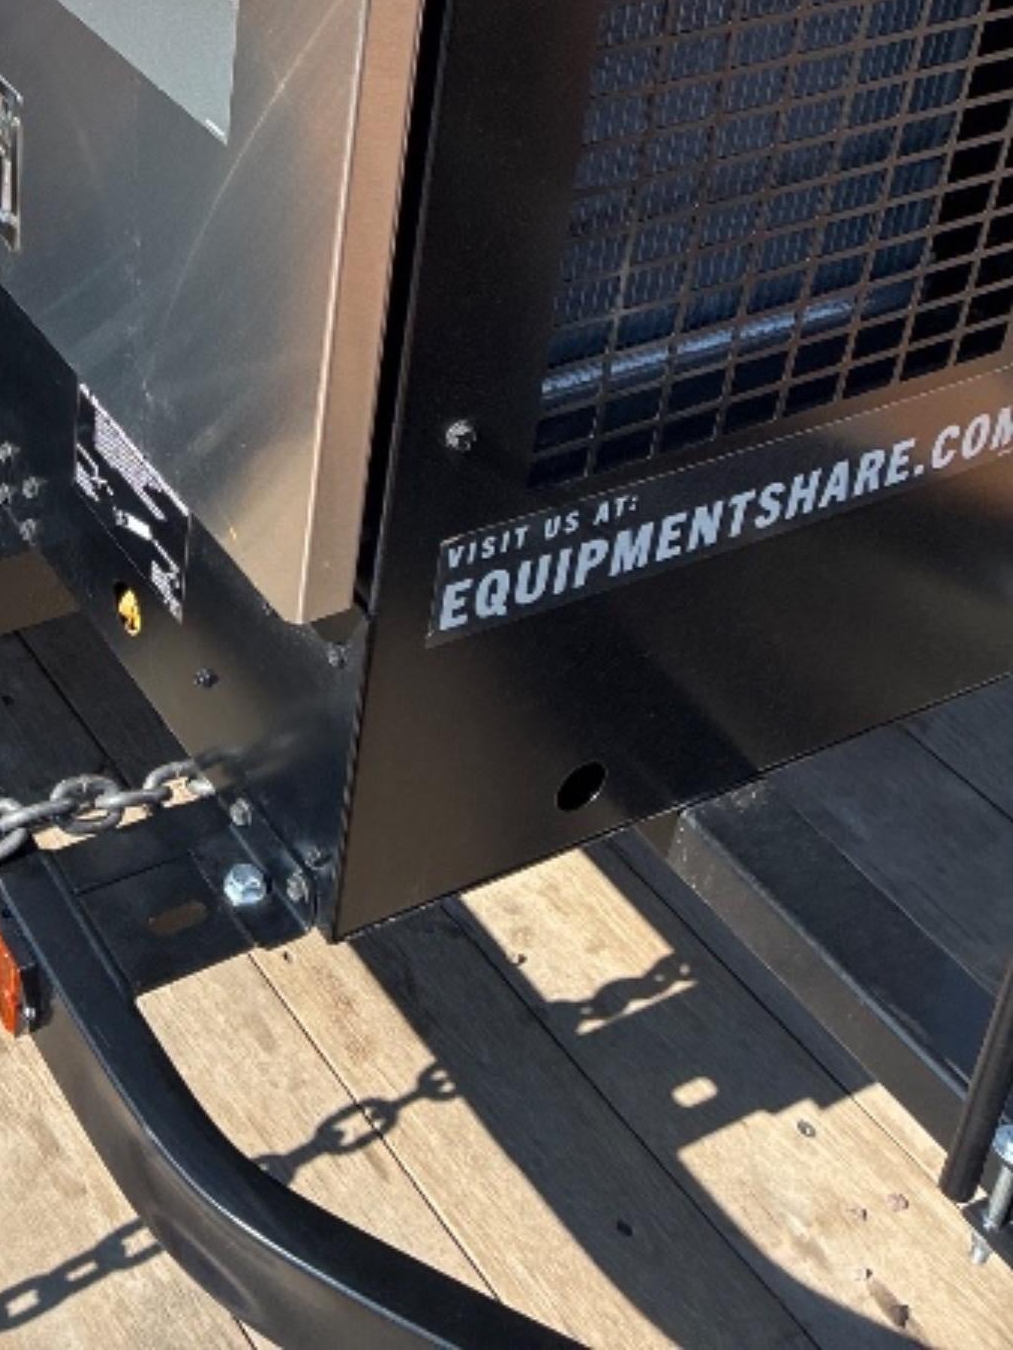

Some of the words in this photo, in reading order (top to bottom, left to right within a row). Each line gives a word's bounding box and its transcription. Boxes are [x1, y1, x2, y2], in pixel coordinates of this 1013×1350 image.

[447, 525, 530, 569] VISIT
[543, 510, 580, 541] US
[592, 495, 637, 526] AT:
